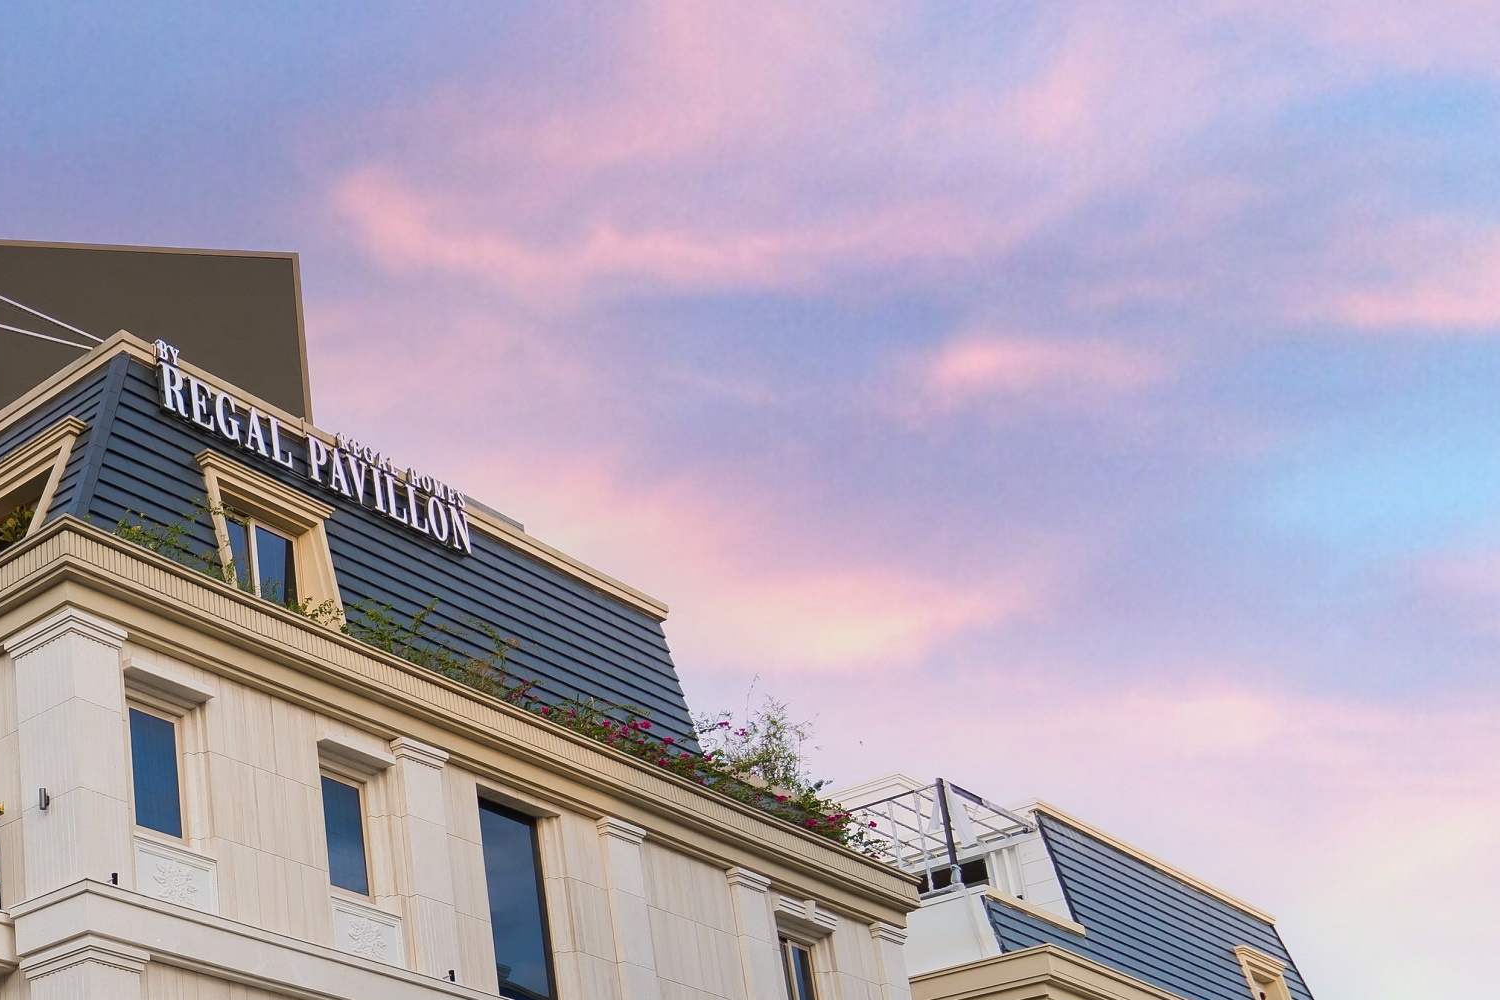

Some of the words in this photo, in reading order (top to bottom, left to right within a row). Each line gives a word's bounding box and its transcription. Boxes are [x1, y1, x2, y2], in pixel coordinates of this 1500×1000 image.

[156, 339, 180, 366] BY
[336, 432, 399, 476] REGAL
[407, 467, 467, 509] HOMES
[159, 361, 293, 469] REGAL
[306, 434, 472, 555] PAVILLON
